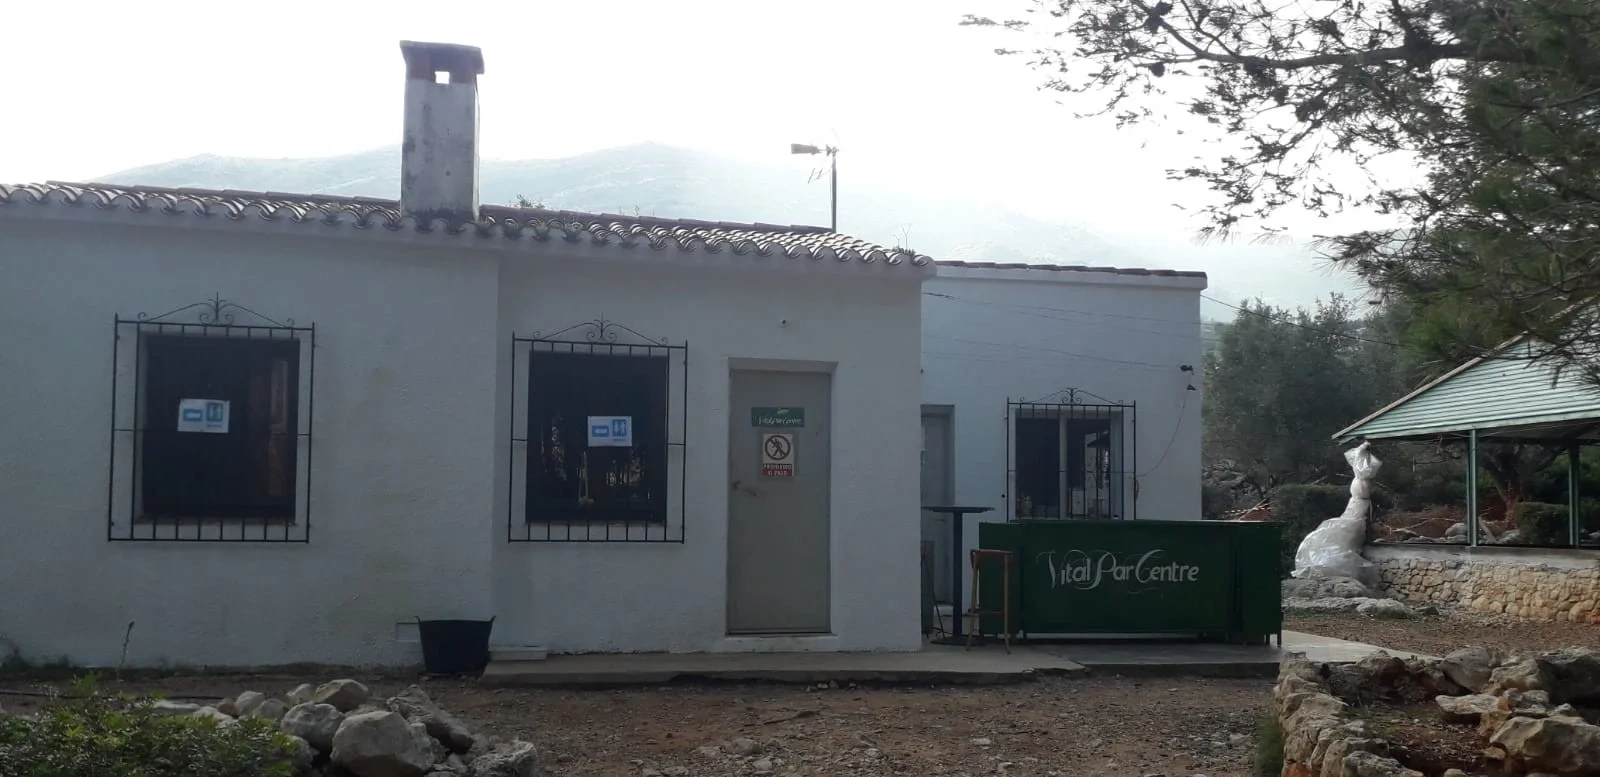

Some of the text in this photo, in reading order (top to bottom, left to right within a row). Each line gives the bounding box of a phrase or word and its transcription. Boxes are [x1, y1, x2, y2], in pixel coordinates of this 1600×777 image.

[1039, 549, 1200, 590] Vital Par Centre
